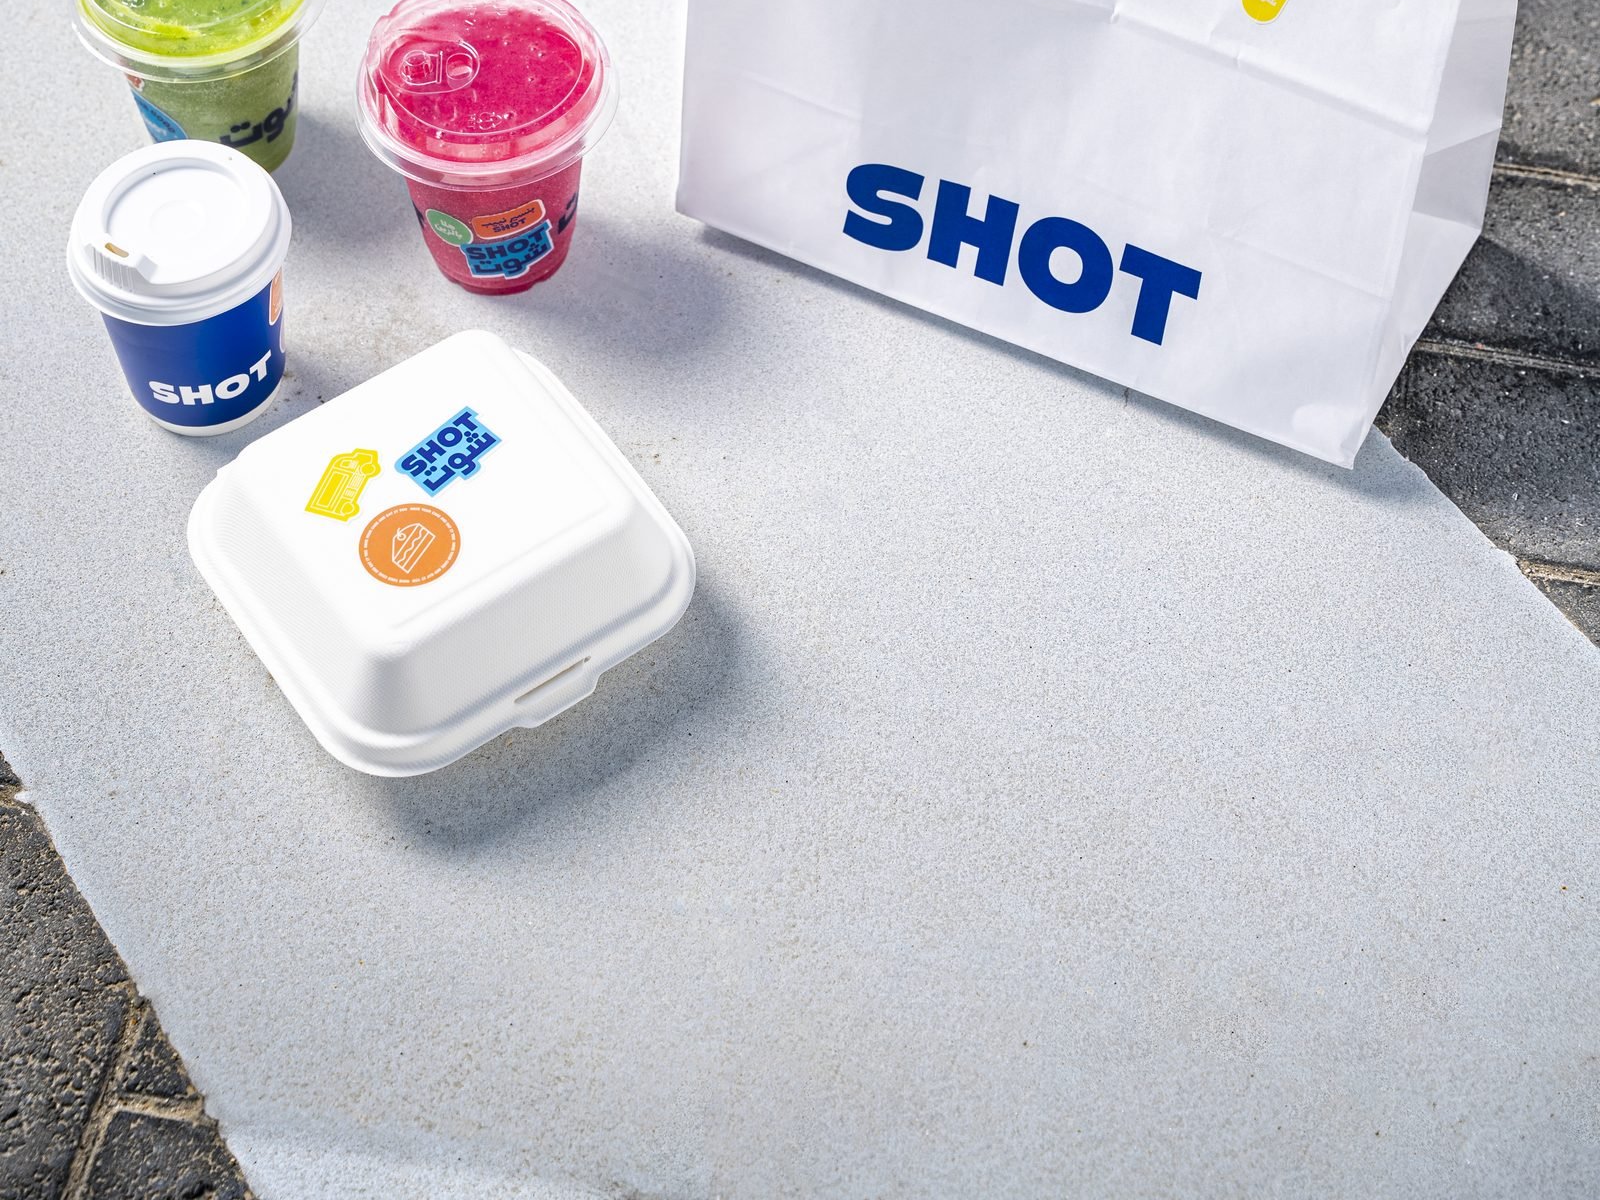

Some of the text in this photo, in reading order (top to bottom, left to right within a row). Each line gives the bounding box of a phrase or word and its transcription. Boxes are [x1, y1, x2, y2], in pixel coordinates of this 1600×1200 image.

[465, 227, 544, 262] SHOT
[493, 218, 526, 232] SHOT
[474, 243, 547, 275] شوت
[843, 163, 1202, 346] SHOT
[149, 350, 272, 406] SHOT
[401, 411, 478, 477] SHOT
[423, 431, 497, 491] شوت
